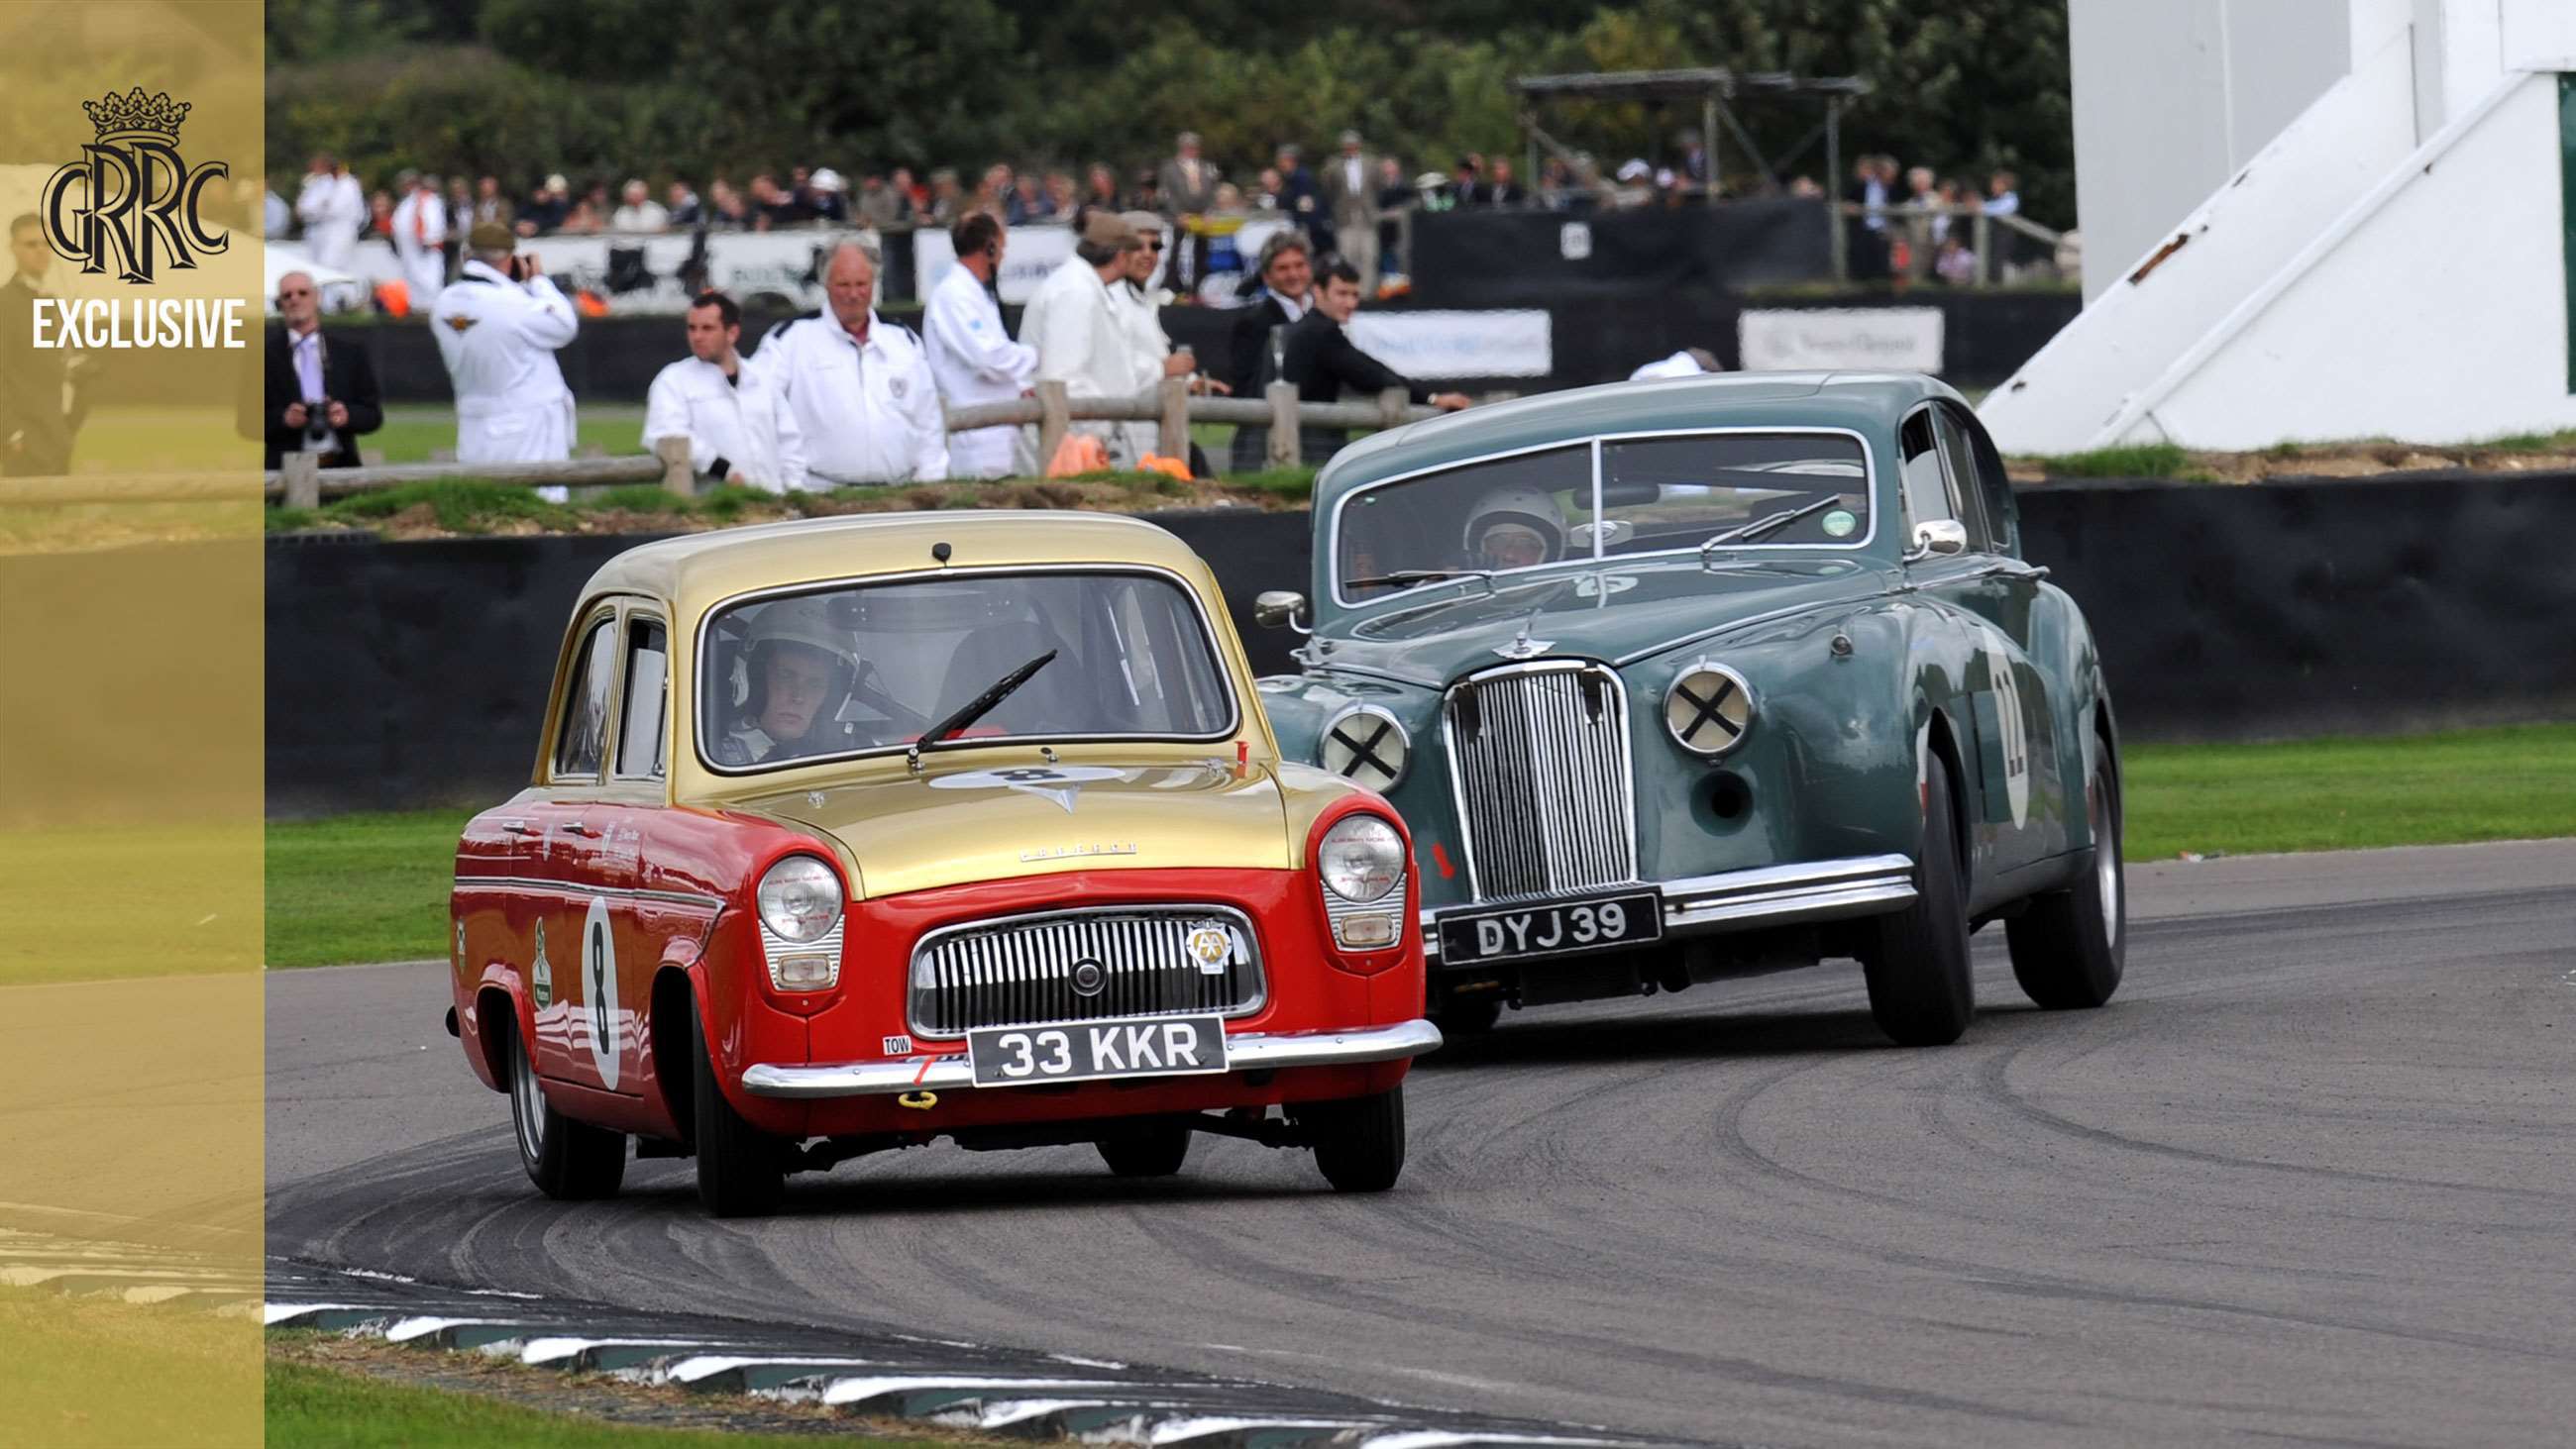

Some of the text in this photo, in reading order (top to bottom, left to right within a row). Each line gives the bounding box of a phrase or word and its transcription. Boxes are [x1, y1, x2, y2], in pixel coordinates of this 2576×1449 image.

[991, 768, 1068, 781] 8
[1196, 932, 1227, 959] AA
[1476, 902, 1627, 956] DYJ 39
[592, 921, 609, 1056] 8
[885, 1038, 910, 1054] TOW
[999, 1022, 1200, 1077] 33 KKR
